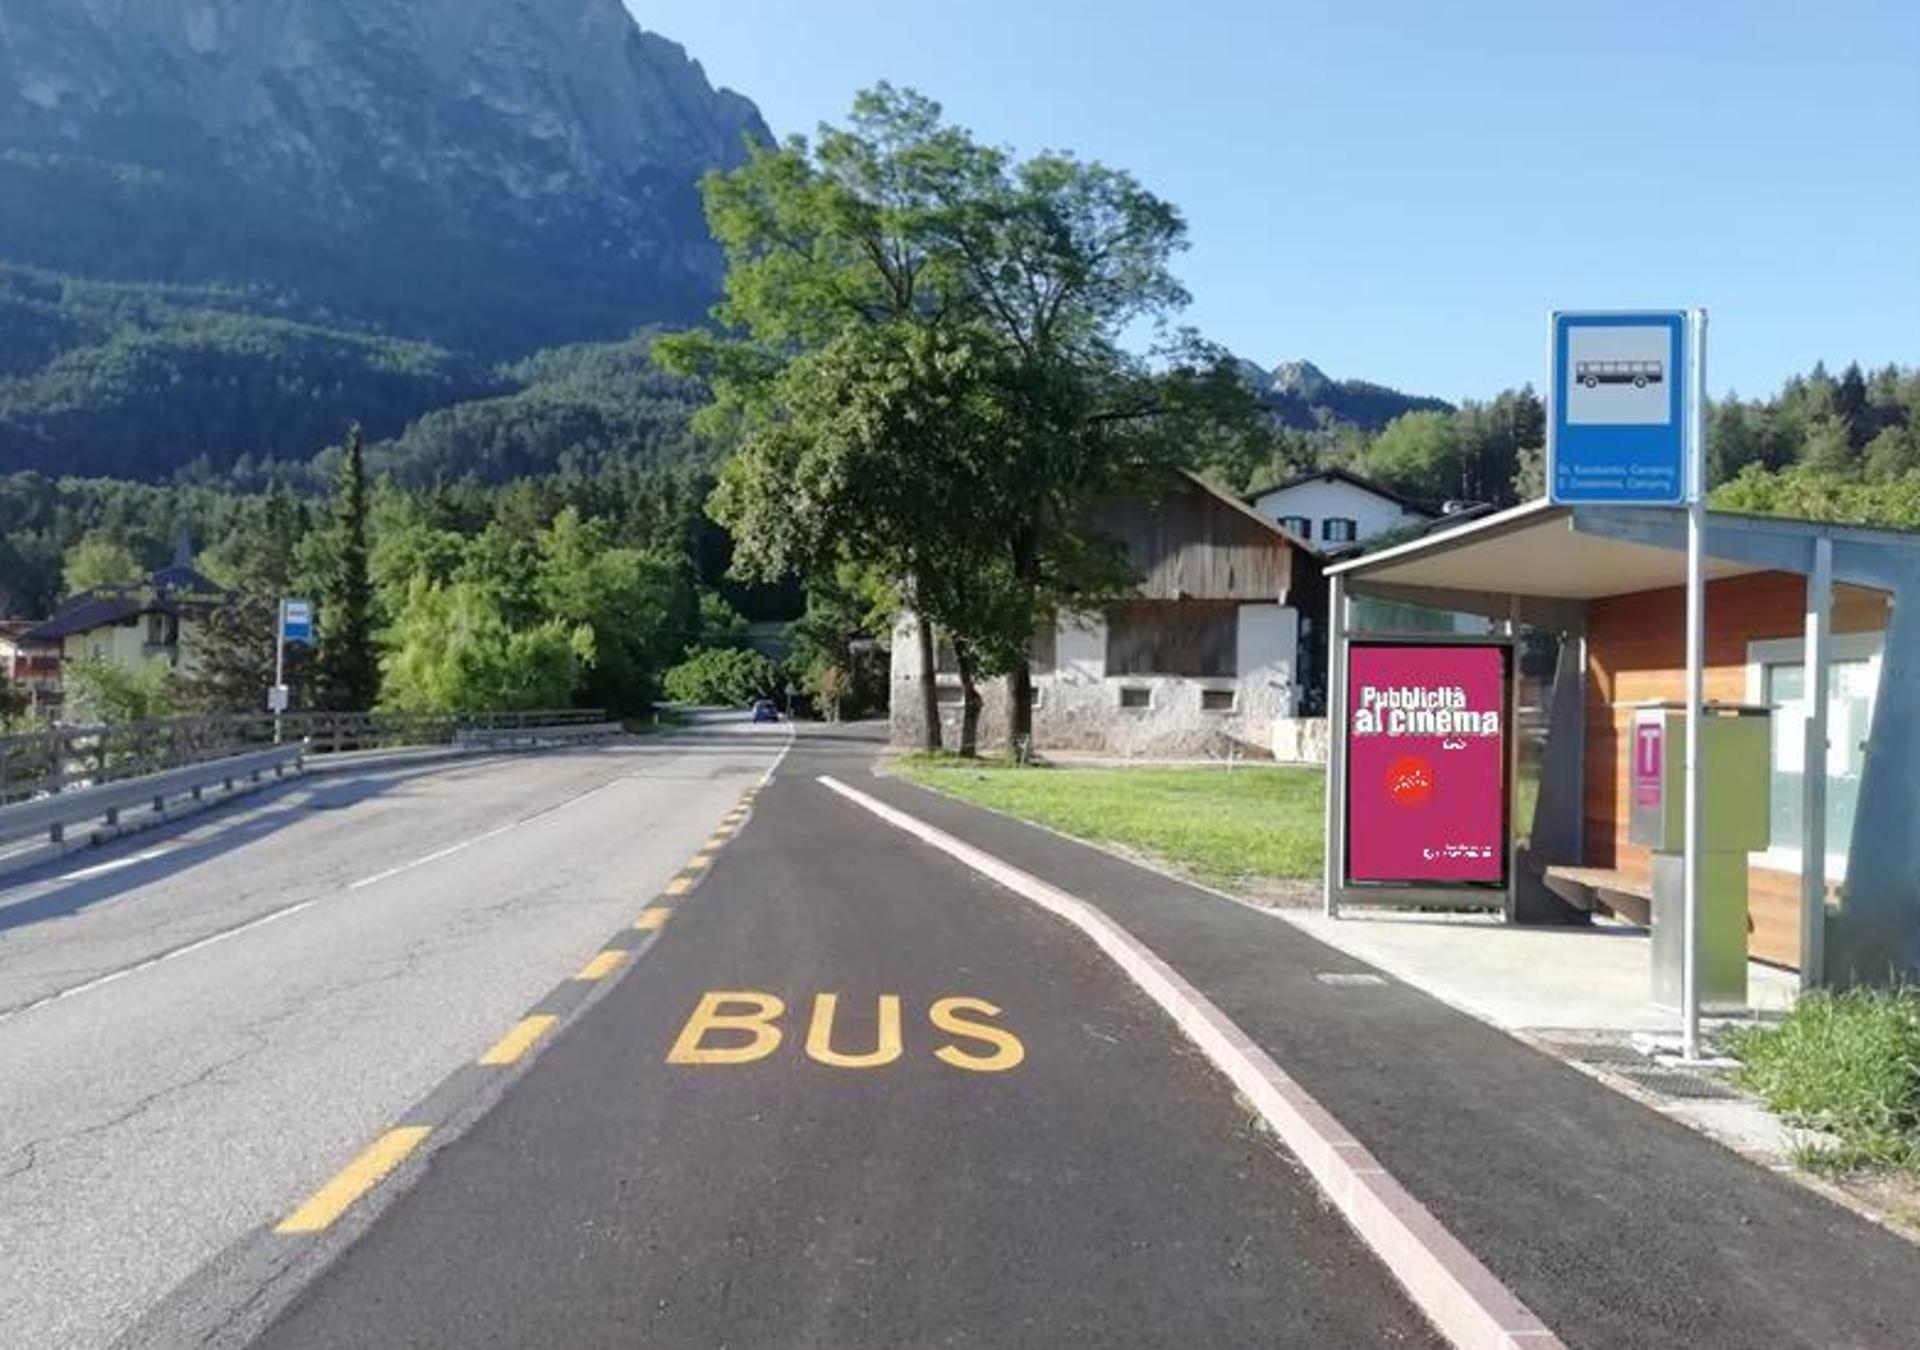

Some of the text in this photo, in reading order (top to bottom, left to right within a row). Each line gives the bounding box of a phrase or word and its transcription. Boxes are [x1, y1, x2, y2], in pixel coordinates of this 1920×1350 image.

[1355, 706, 1499, 733] al cinema
[665, 991, 1025, 1072] BUS
